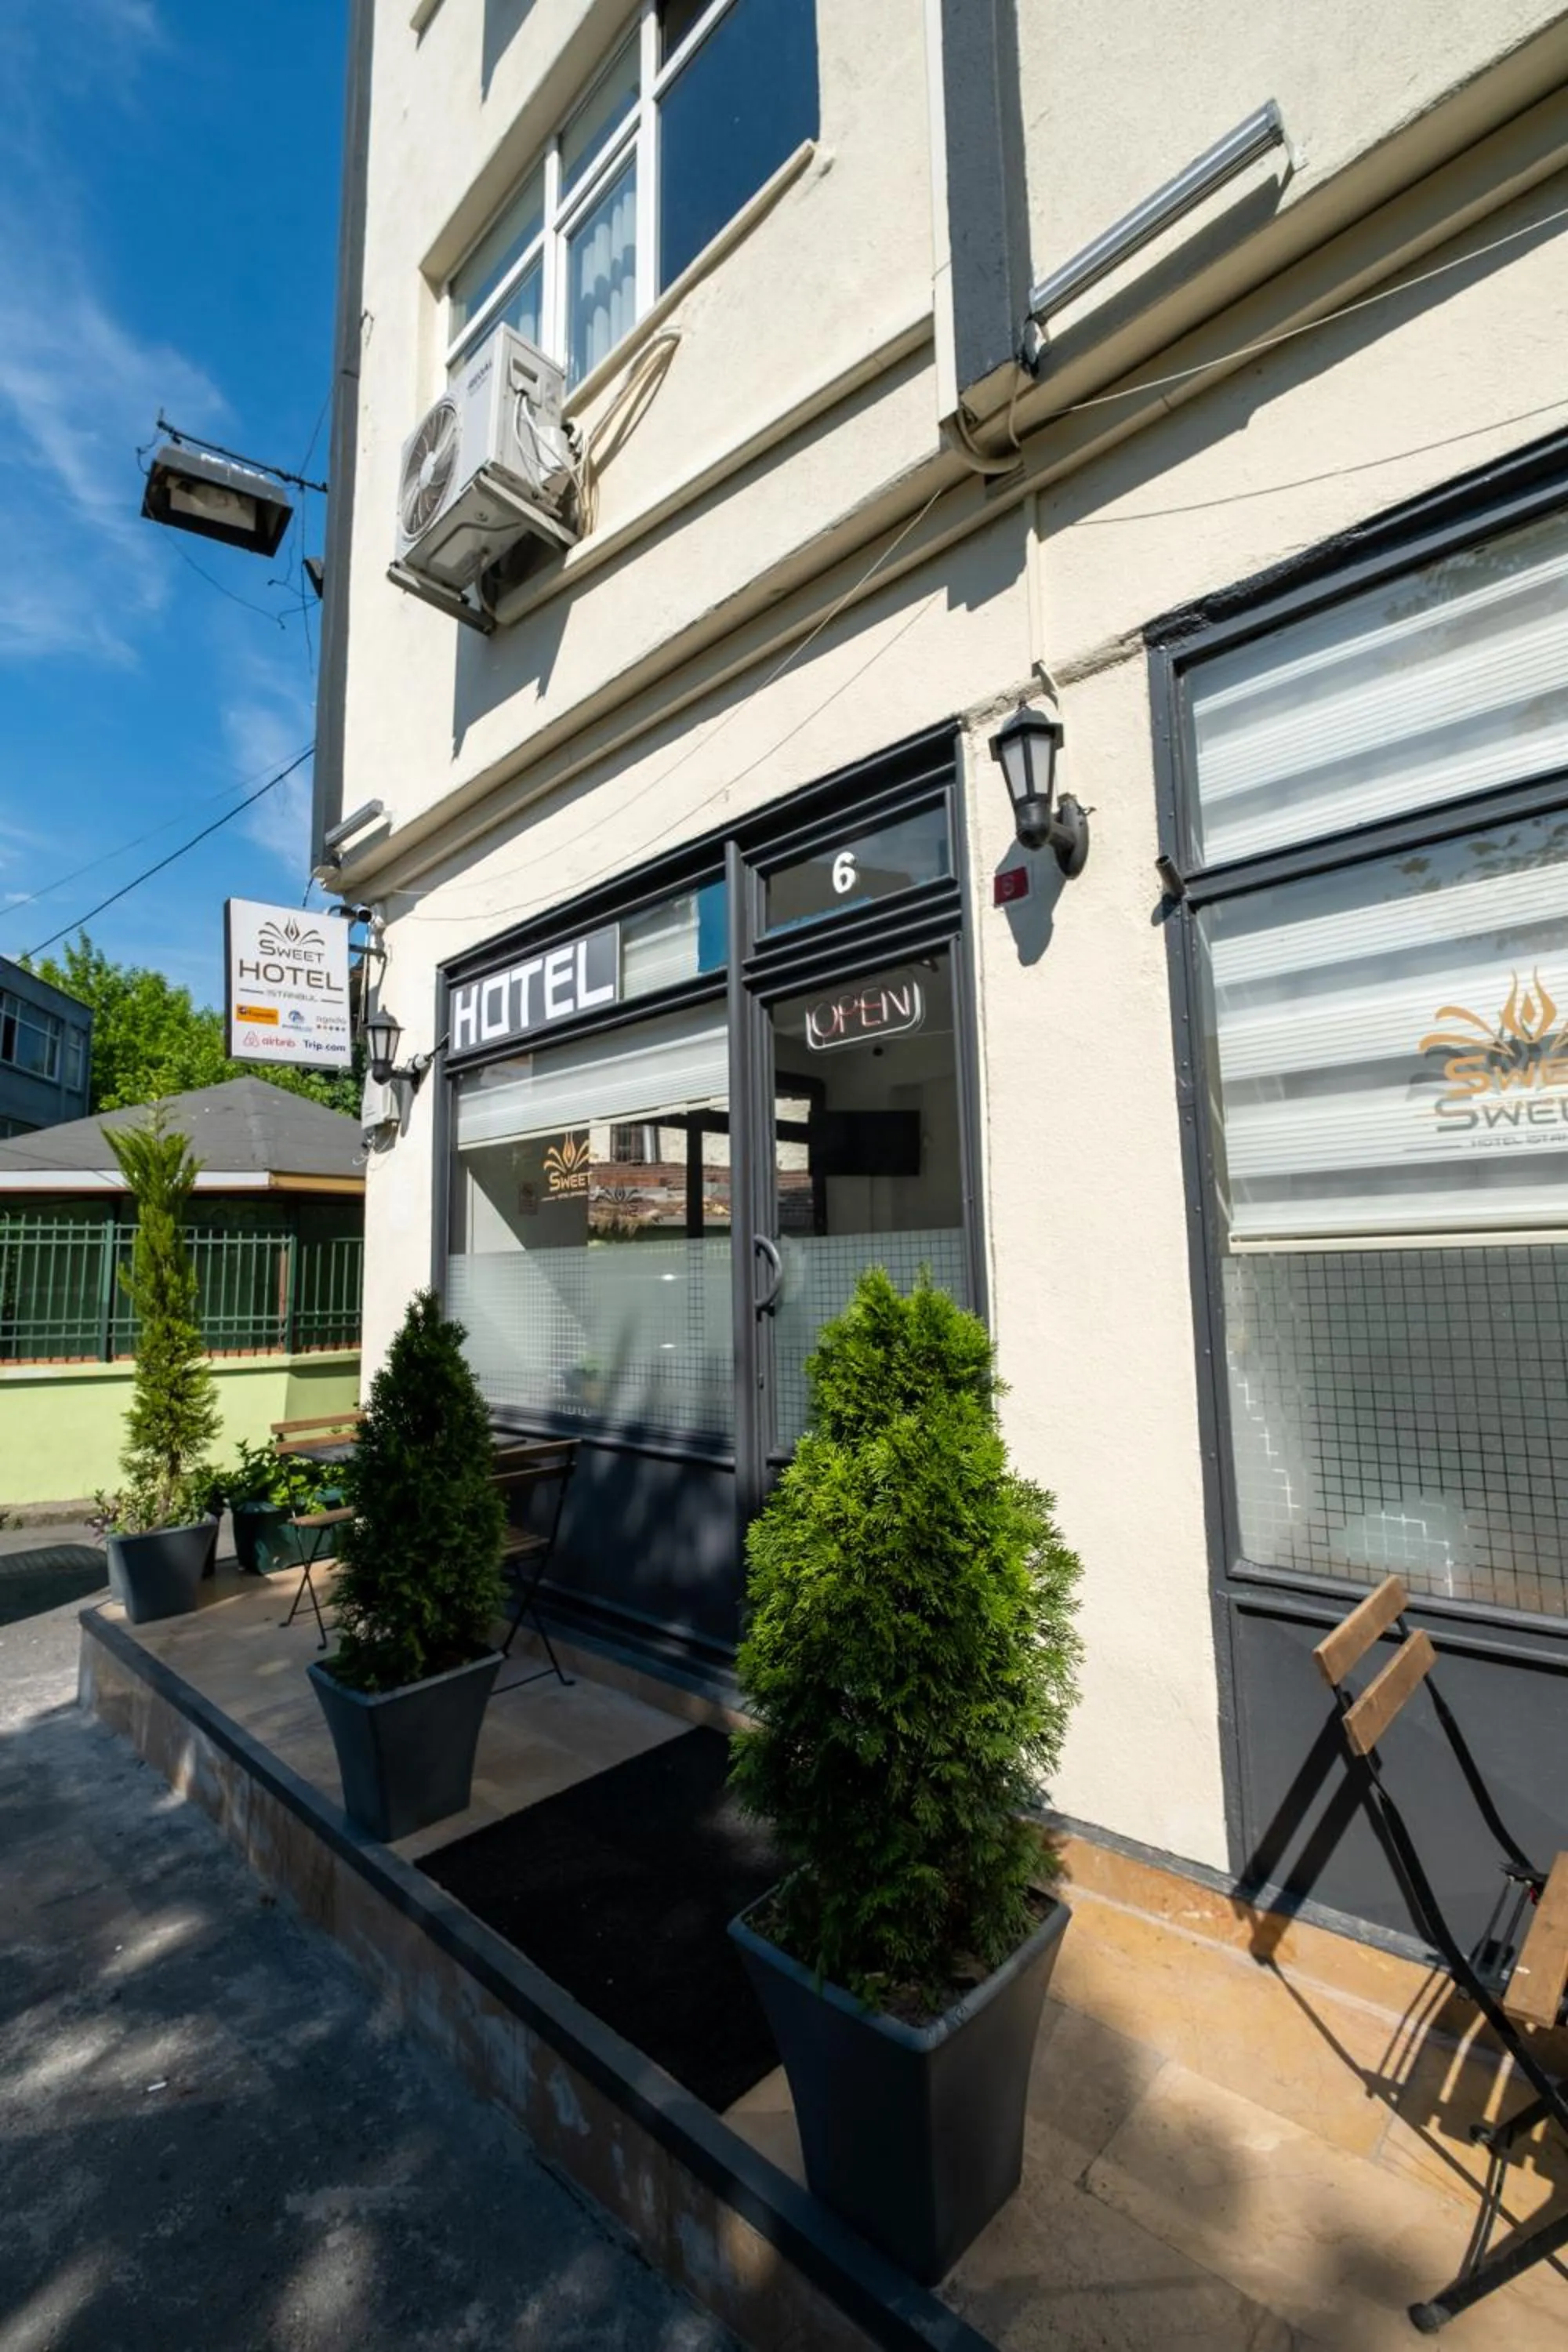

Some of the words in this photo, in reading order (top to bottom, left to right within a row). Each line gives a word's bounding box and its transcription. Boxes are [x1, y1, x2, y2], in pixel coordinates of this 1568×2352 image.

[833, 851, 855, 893] 6
[260, 939, 325, 964] SWEET
[239, 958, 343, 992] HOTEL
[454, 941, 614, 1051] HOTEL
[811, 985, 910, 1037] OPEN
[261, 1036, 296, 1048] airbnb
[303, 1039, 346, 1052] Trip.com
[549, 1171, 593, 1192] SWEET
